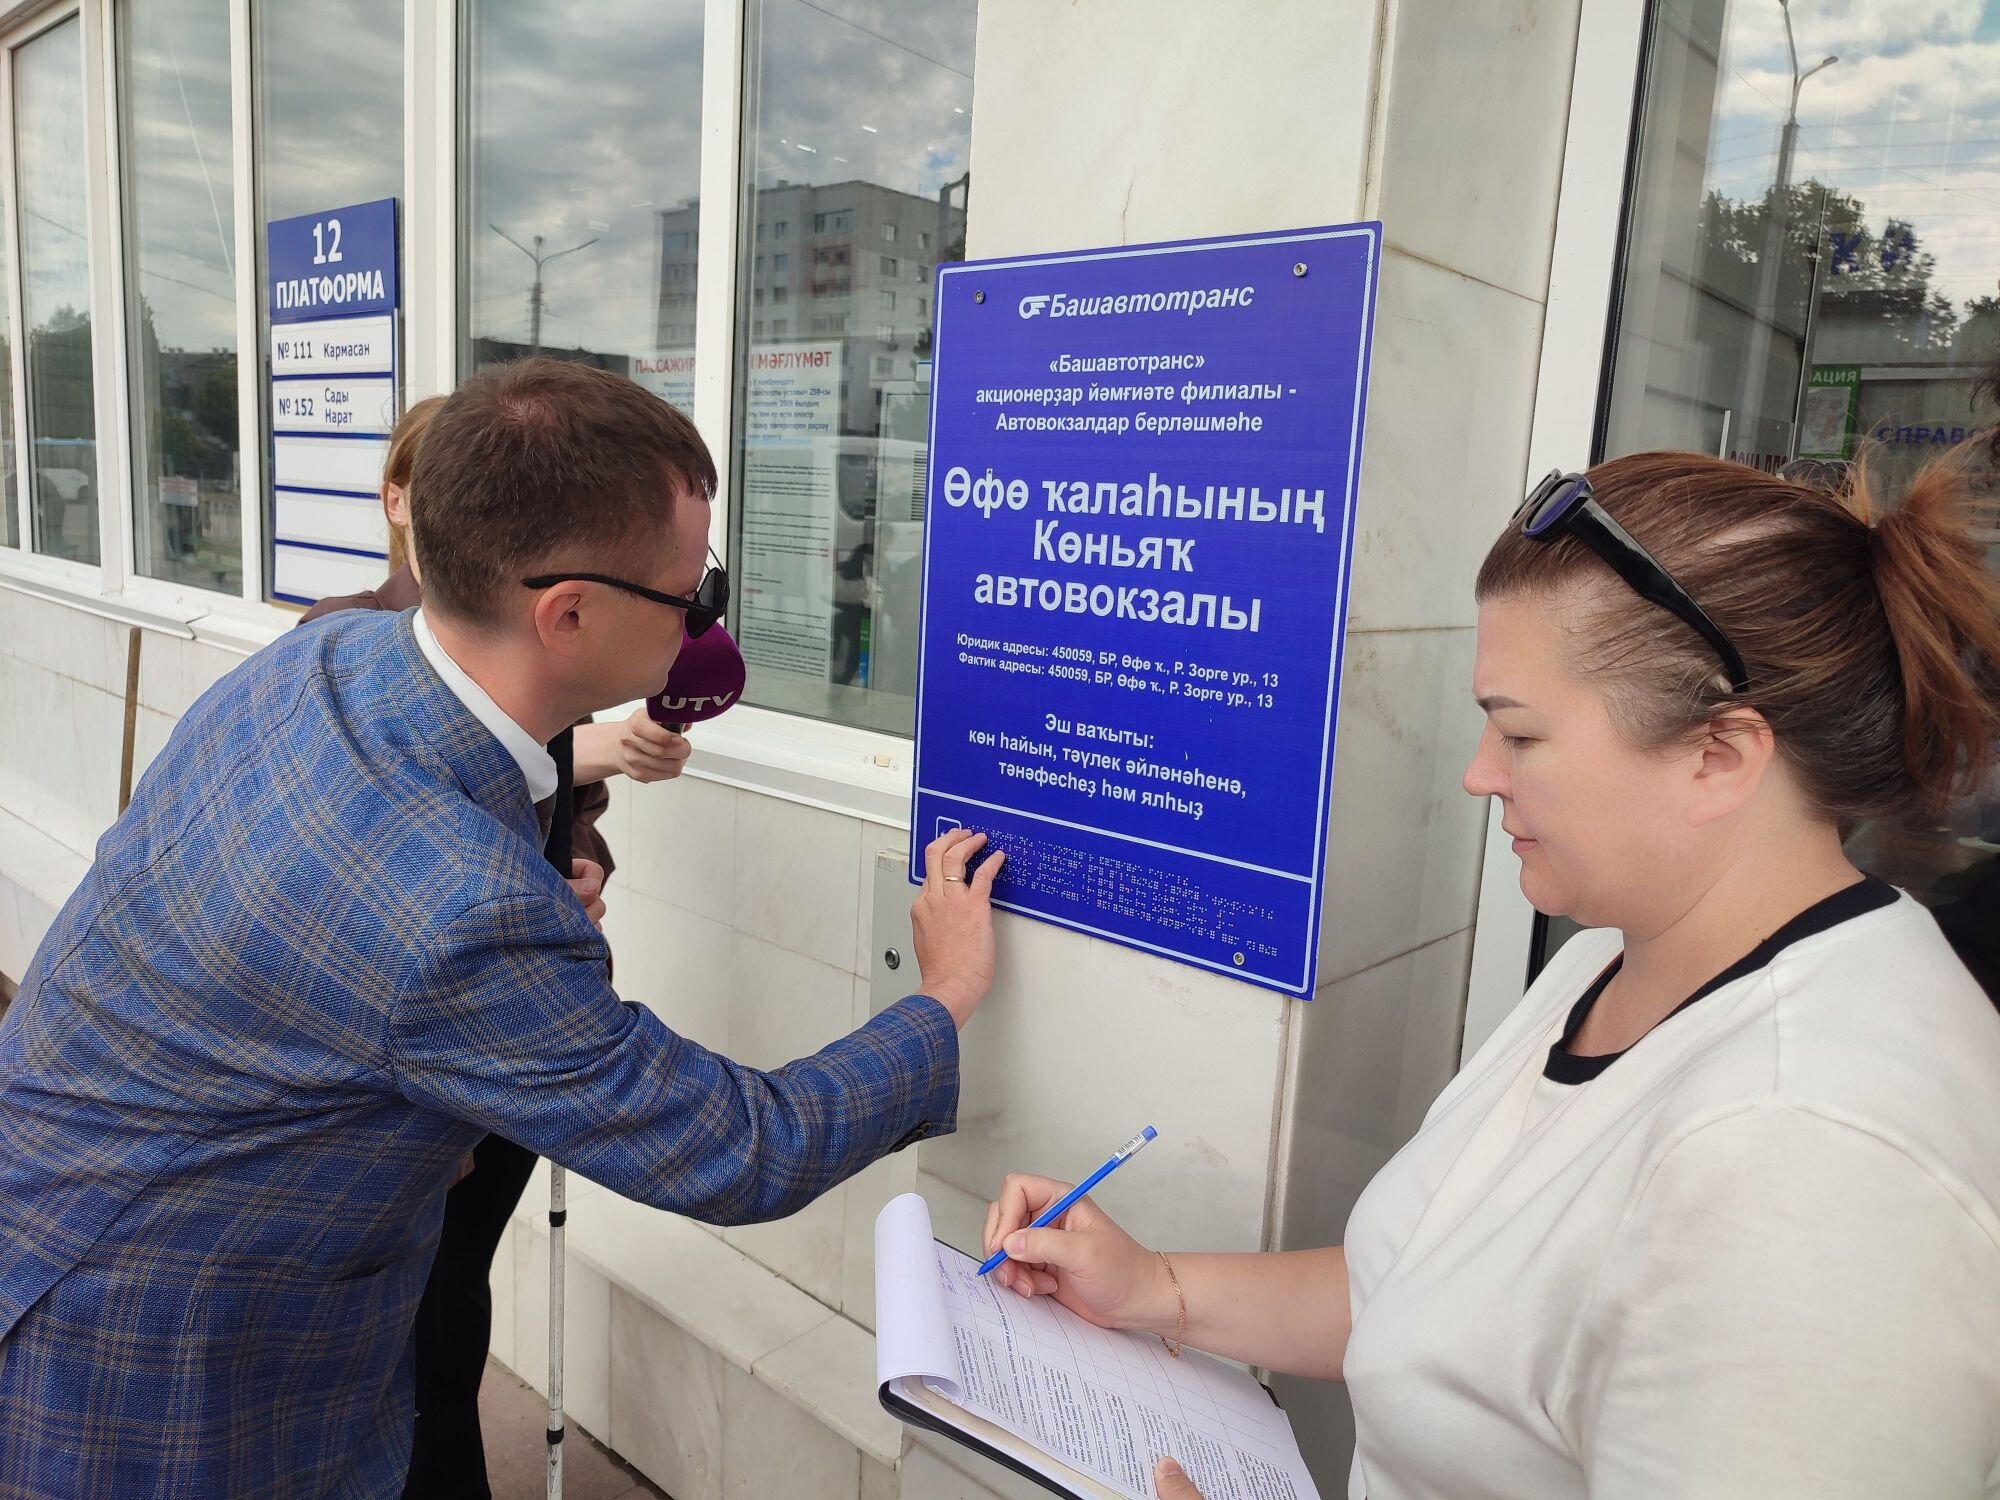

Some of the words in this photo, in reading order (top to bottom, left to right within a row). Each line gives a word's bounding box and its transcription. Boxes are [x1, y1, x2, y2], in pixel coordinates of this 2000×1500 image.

[313, 219, 342, 265] 12
[277, 270, 385, 309] ПЛАТФОРМА
[1049, 286, 1255, 318] Башавтотранс
[278, 342, 290, 361] №
[293, 341, 313, 361] 111
[323, 343, 370, 360] Кармасан
[1049, 354, 1206, 375] «Башавтотранс»
[975, 387, 1084, 407] акционерҙар
[1088, 382, 1175, 402] йәмғиәте
[1180, 380, 1282, 405] филиалы
[1811, 371, 1857, 385] АЦИЯ
[279, 399, 291, 416] №
[294, 398, 314, 417] 152
[324, 387, 349, 404] Сады
[325, 408, 353, 426] Нарат
[995, 412, 1130, 436] Автовокзалдар
[1134, 411, 1263, 436] берләшмәһе
[943, 466, 1029, 519] Өфө
[1041, 472, 1325, 534] ҡалаһының
[1033, 519, 1196, 573] Көньяҡ
[974, 573, 1261, 633] автовокзалы
[957, 633, 1001, 651] Юридик
[1002, 642, 1049, 657] адресы:
[1051, 645, 1095, 665] 450059,
[1099, 651, 1118, 669] БР,
[1121, 654, 1151, 672] Өфө
[1174, 661, 1185, 675] Р.
[1188, 663, 1229, 682] Зорге
[1231, 671, 1257, 688] ур.,
[1262, 672, 1279, 688] 13
[958, 651, 997, 668] Фактик
[998, 659, 1045, 675] адресы:
[1047, 664, 1091, 684] 450059,
[1094, 670, 1113, 687] БР,
[1117, 673, 1147, 692] Өфө
[1169, 681, 1180, 695] Р.
[1183, 683, 1224, 702] Зорге
[1226, 692, 1252, 708] ур.,
[1257, 693, 1273, 708] 13
[661, 690, 735, 712] UTV
[1045, 713, 1071, 734] Эш
[1076, 722, 1154, 749] ваҡыты:
[969, 730, 995, 747] көн
[1000, 731, 1057, 762] һайын,
[1062, 747, 1121, 772] тәүлек
[1125, 757, 1246, 799] әйләнәһенә,
[998, 761, 1097, 798] тәнәфесһеҙ
[1101, 778, 1136, 803] һәм
[1141, 791, 1203, 821] ялһыҙ
